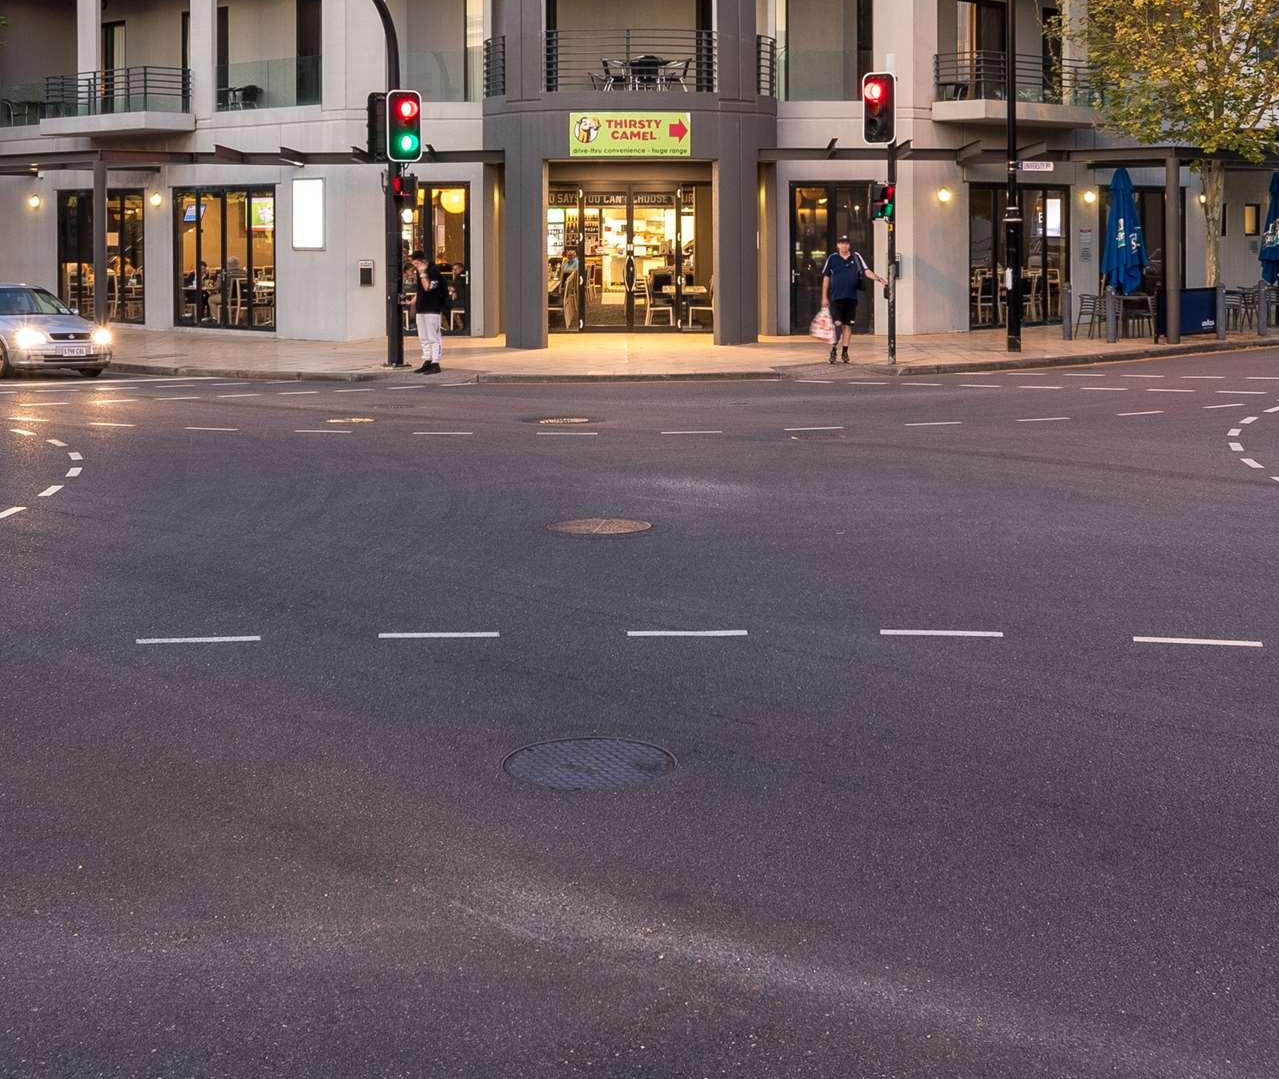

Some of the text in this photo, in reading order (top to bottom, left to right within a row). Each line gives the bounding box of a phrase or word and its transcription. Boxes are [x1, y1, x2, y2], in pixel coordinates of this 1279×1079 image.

[606, 119, 662, 129] THIRSTY
[611, 131, 656, 141] CAMEL
[652, 147, 668, 155] huge
